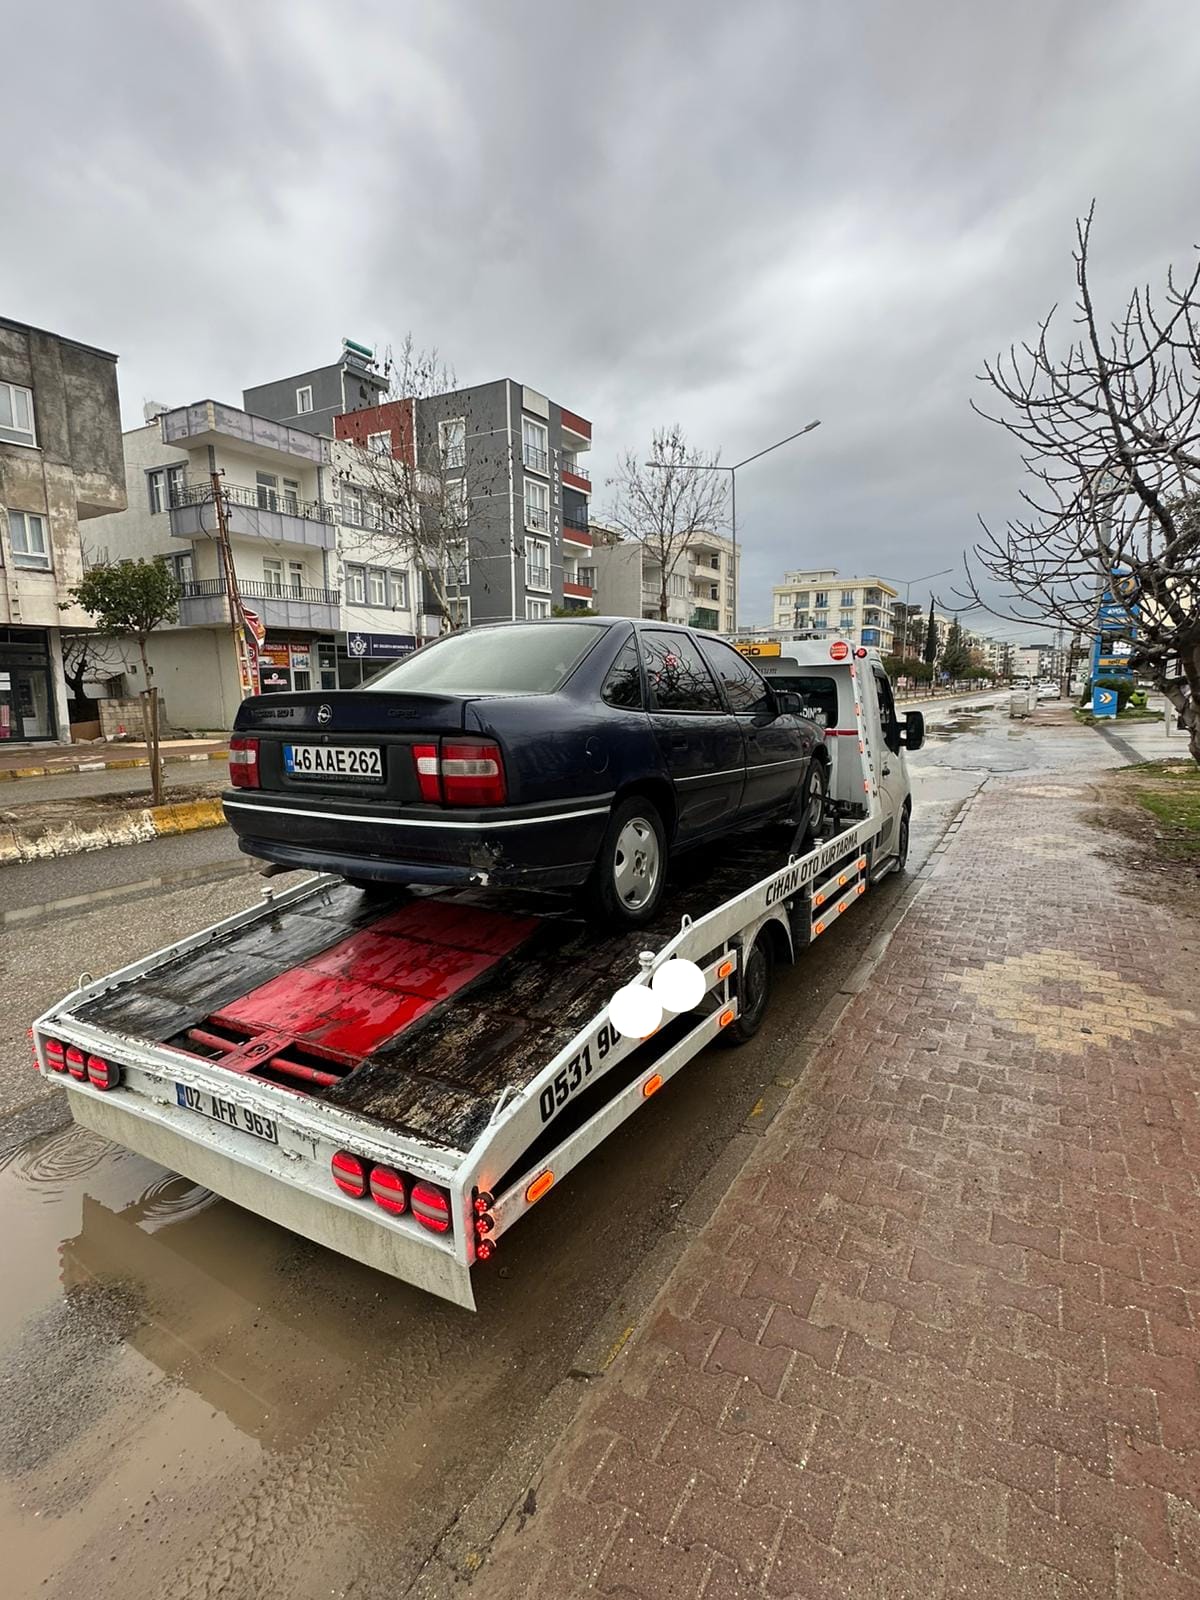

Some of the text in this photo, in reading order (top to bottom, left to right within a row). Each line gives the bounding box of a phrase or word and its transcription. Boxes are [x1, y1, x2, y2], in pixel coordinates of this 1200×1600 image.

[294, 749, 381, 774] 46 AAE 262
[801, 856, 819, 882] OTO
[820, 831, 858, 869] KURTARMA
[539, 1044, 593, 1123] 0531
[185, 1086, 274, 1139] 02 AFR 963
